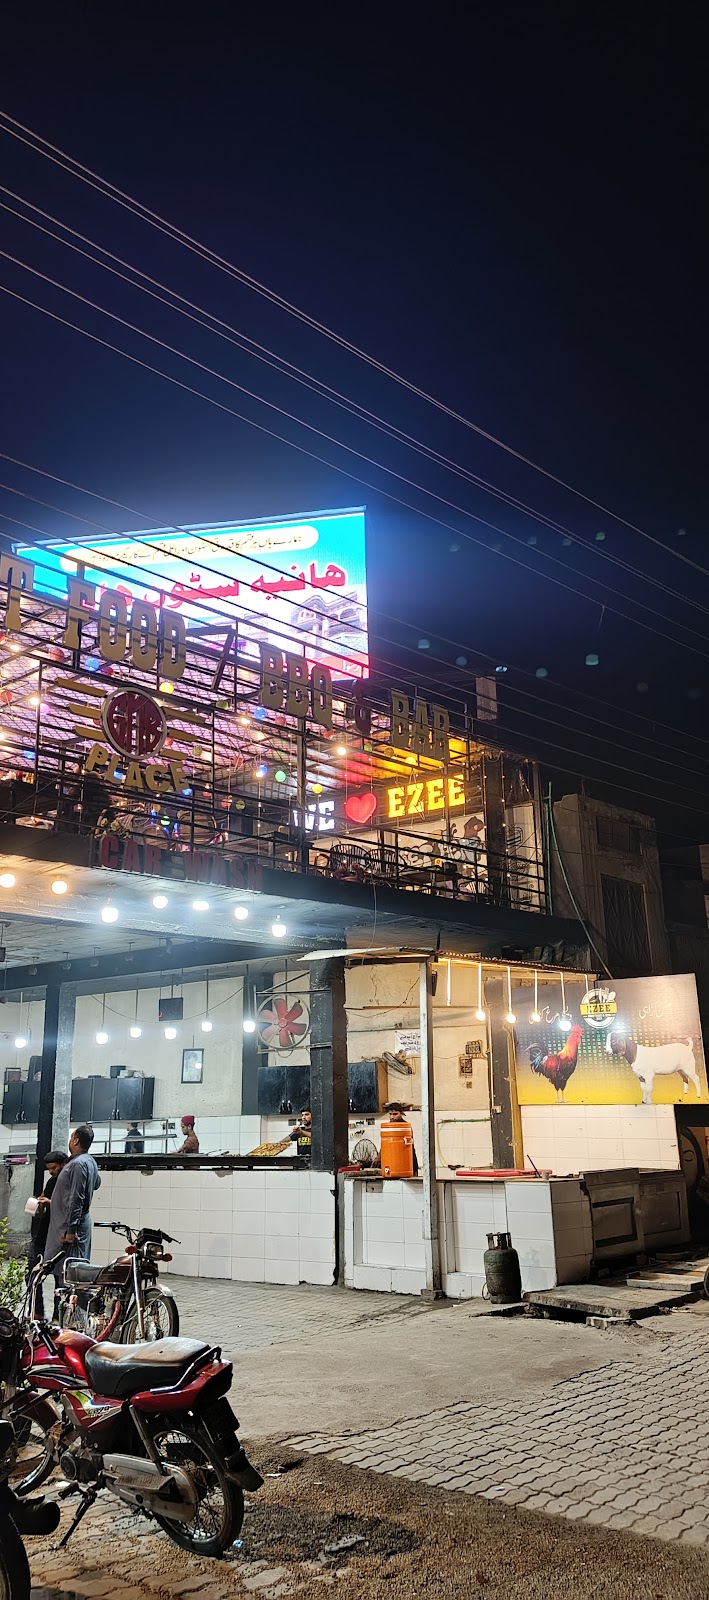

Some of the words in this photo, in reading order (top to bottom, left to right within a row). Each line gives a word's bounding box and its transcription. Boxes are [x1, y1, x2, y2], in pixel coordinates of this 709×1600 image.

[64, 576, 186, 680] FOOD
[260, 642, 333, 731] BBQ
[391, 688, 450, 762] BAR
[85, 743, 190, 792] PLACE
[293, 800, 335, 833] WE
[388, 774, 465, 818] EZEE
[101, 835, 161, 876] CAR
[184, 851, 263, 893] WASH
